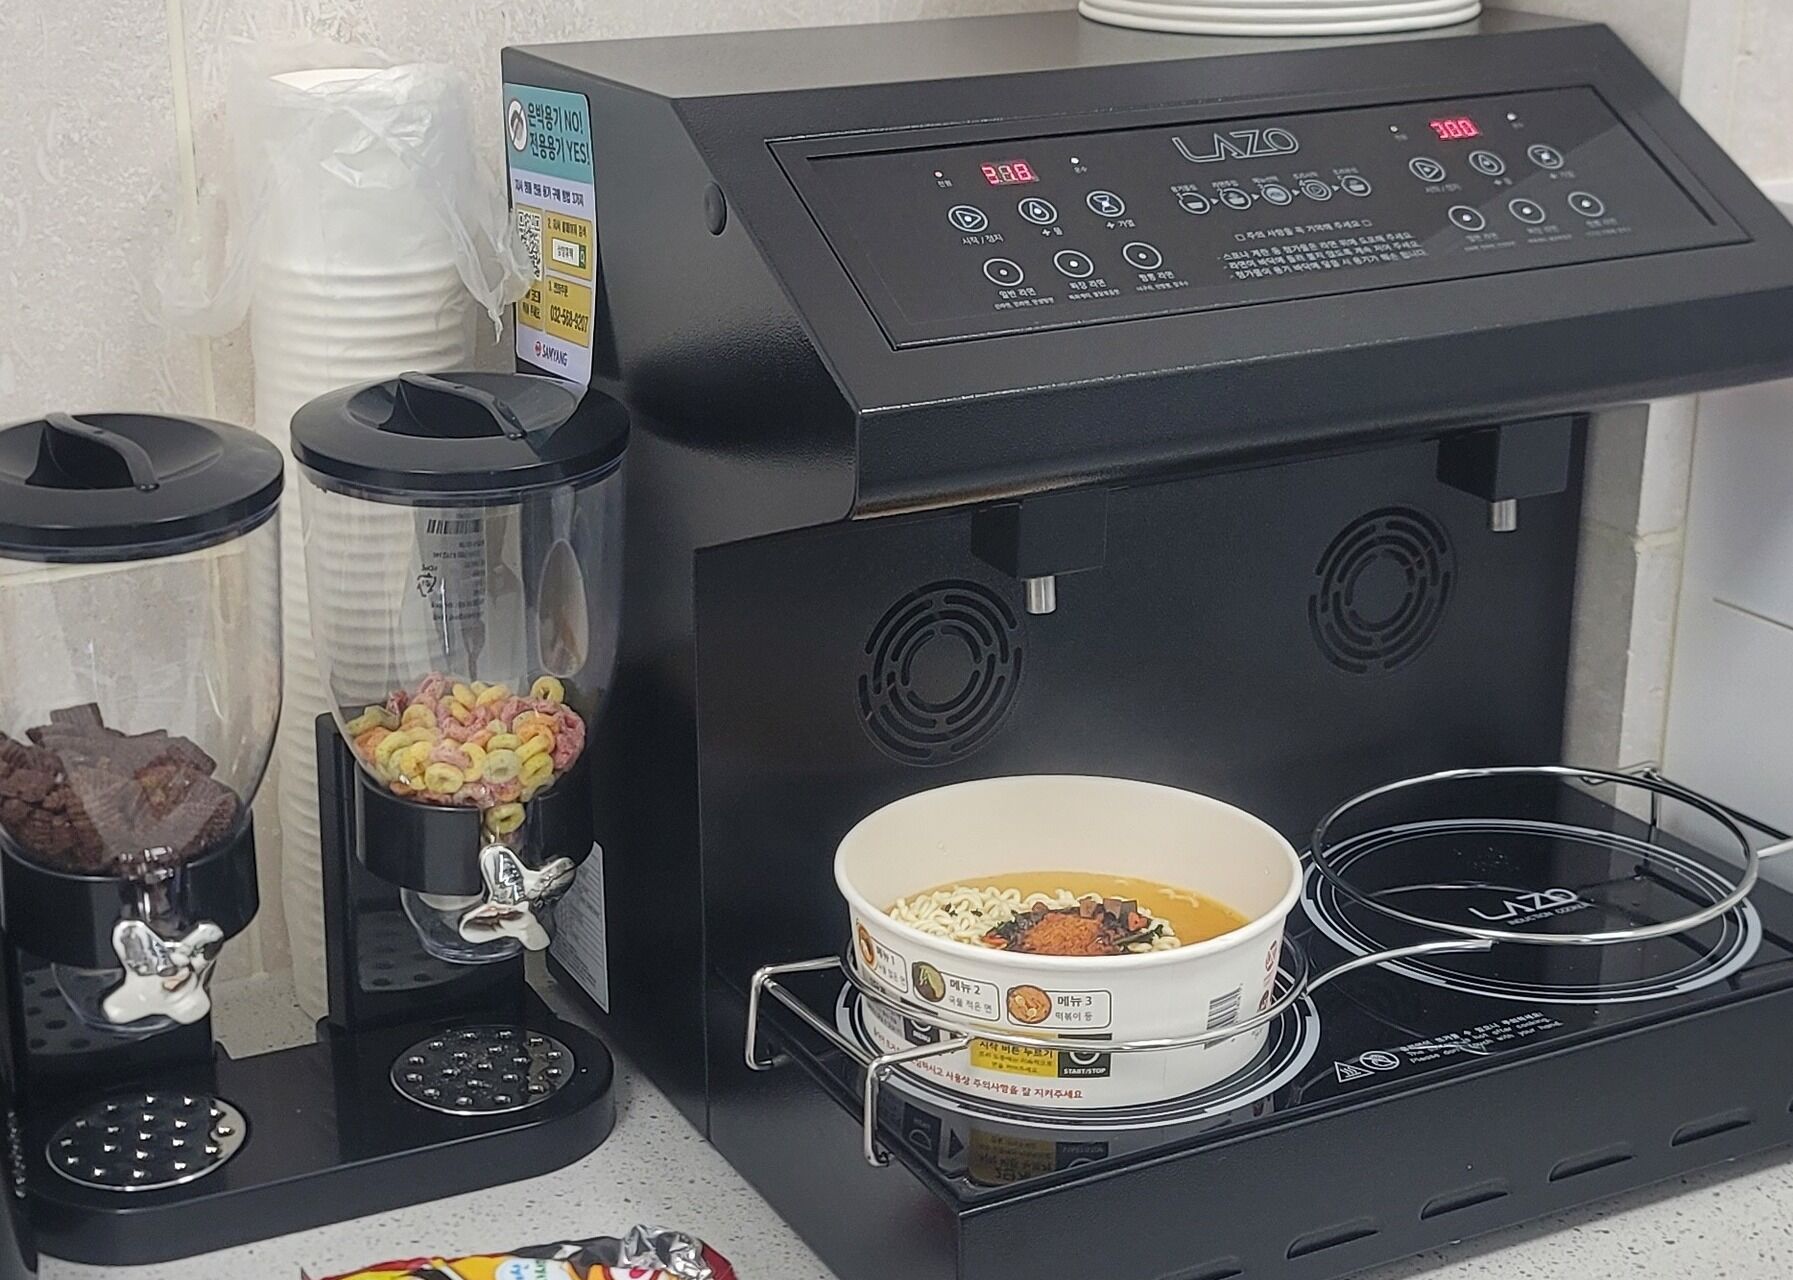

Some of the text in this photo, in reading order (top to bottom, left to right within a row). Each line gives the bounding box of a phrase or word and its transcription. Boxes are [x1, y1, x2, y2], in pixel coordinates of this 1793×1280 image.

[527, 102, 584, 135] 은박용기 NO!
[529, 131, 591, 166] 전용용기 YES!
[1172, 127, 1300, 163] LAZO
[1467, 888, 1578, 921] LAZO
[950, 978, 981, 996] 메뉴 2
[1057, 995, 1093, 1007] 메뉴 3
[1055, 1011, 1082, 1022] 떡볶이
[1063, 1067, 1107, 1076] START/STOP
[945, 1072, 971, 1087] 사용상
[973, 1078, 1019, 1096] 주의사항을
[1021, 1087, 1032, 1097] 잘
